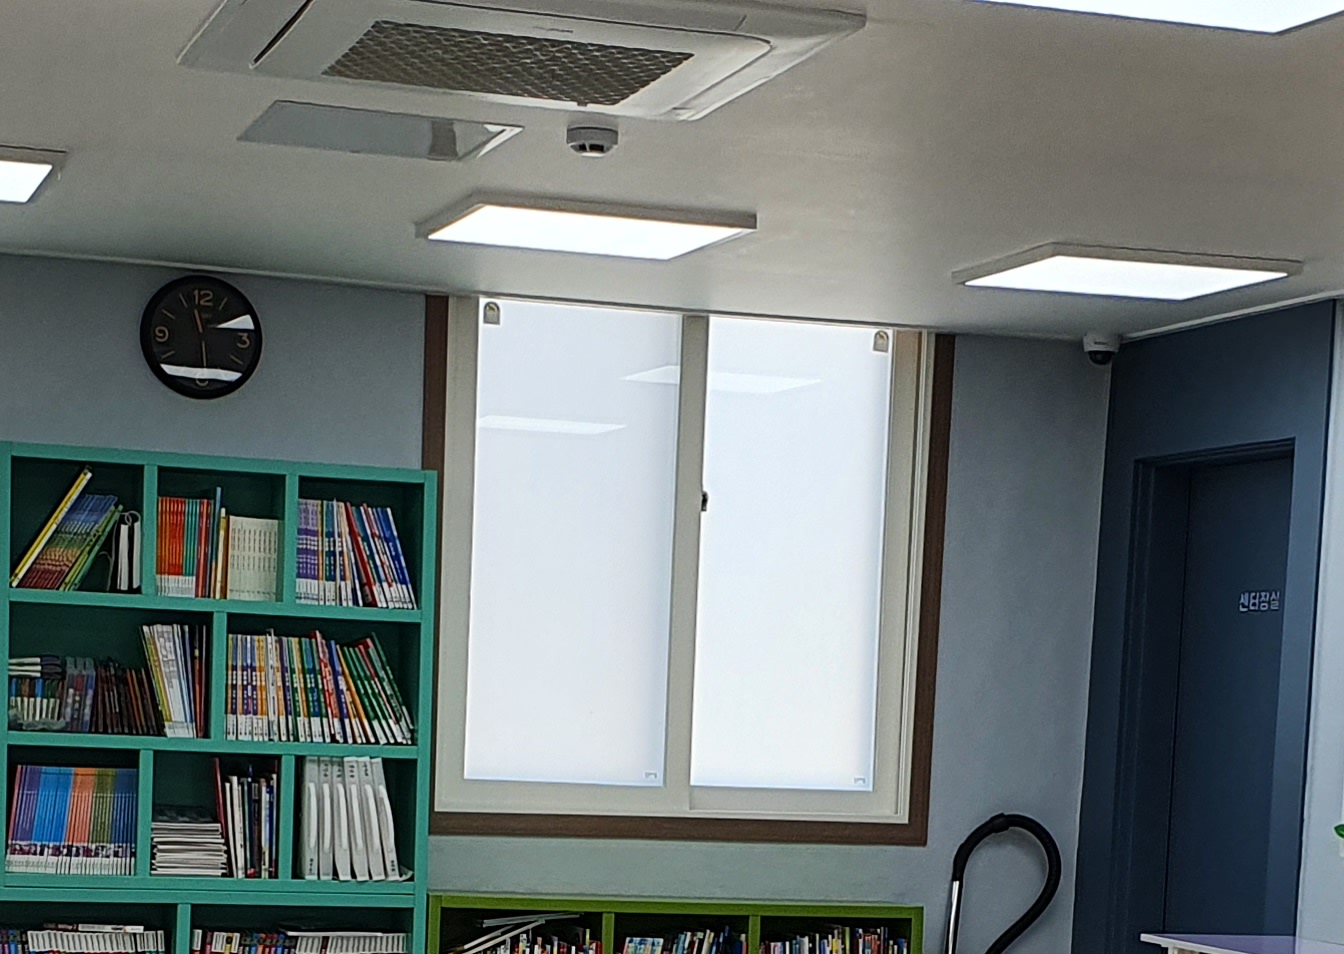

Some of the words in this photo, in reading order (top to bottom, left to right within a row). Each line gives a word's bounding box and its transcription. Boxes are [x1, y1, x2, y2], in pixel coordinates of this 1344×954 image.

[193, 289, 213, 306] 12
[155, 326, 169, 342] 9
[236, 332, 250, 348] 3
